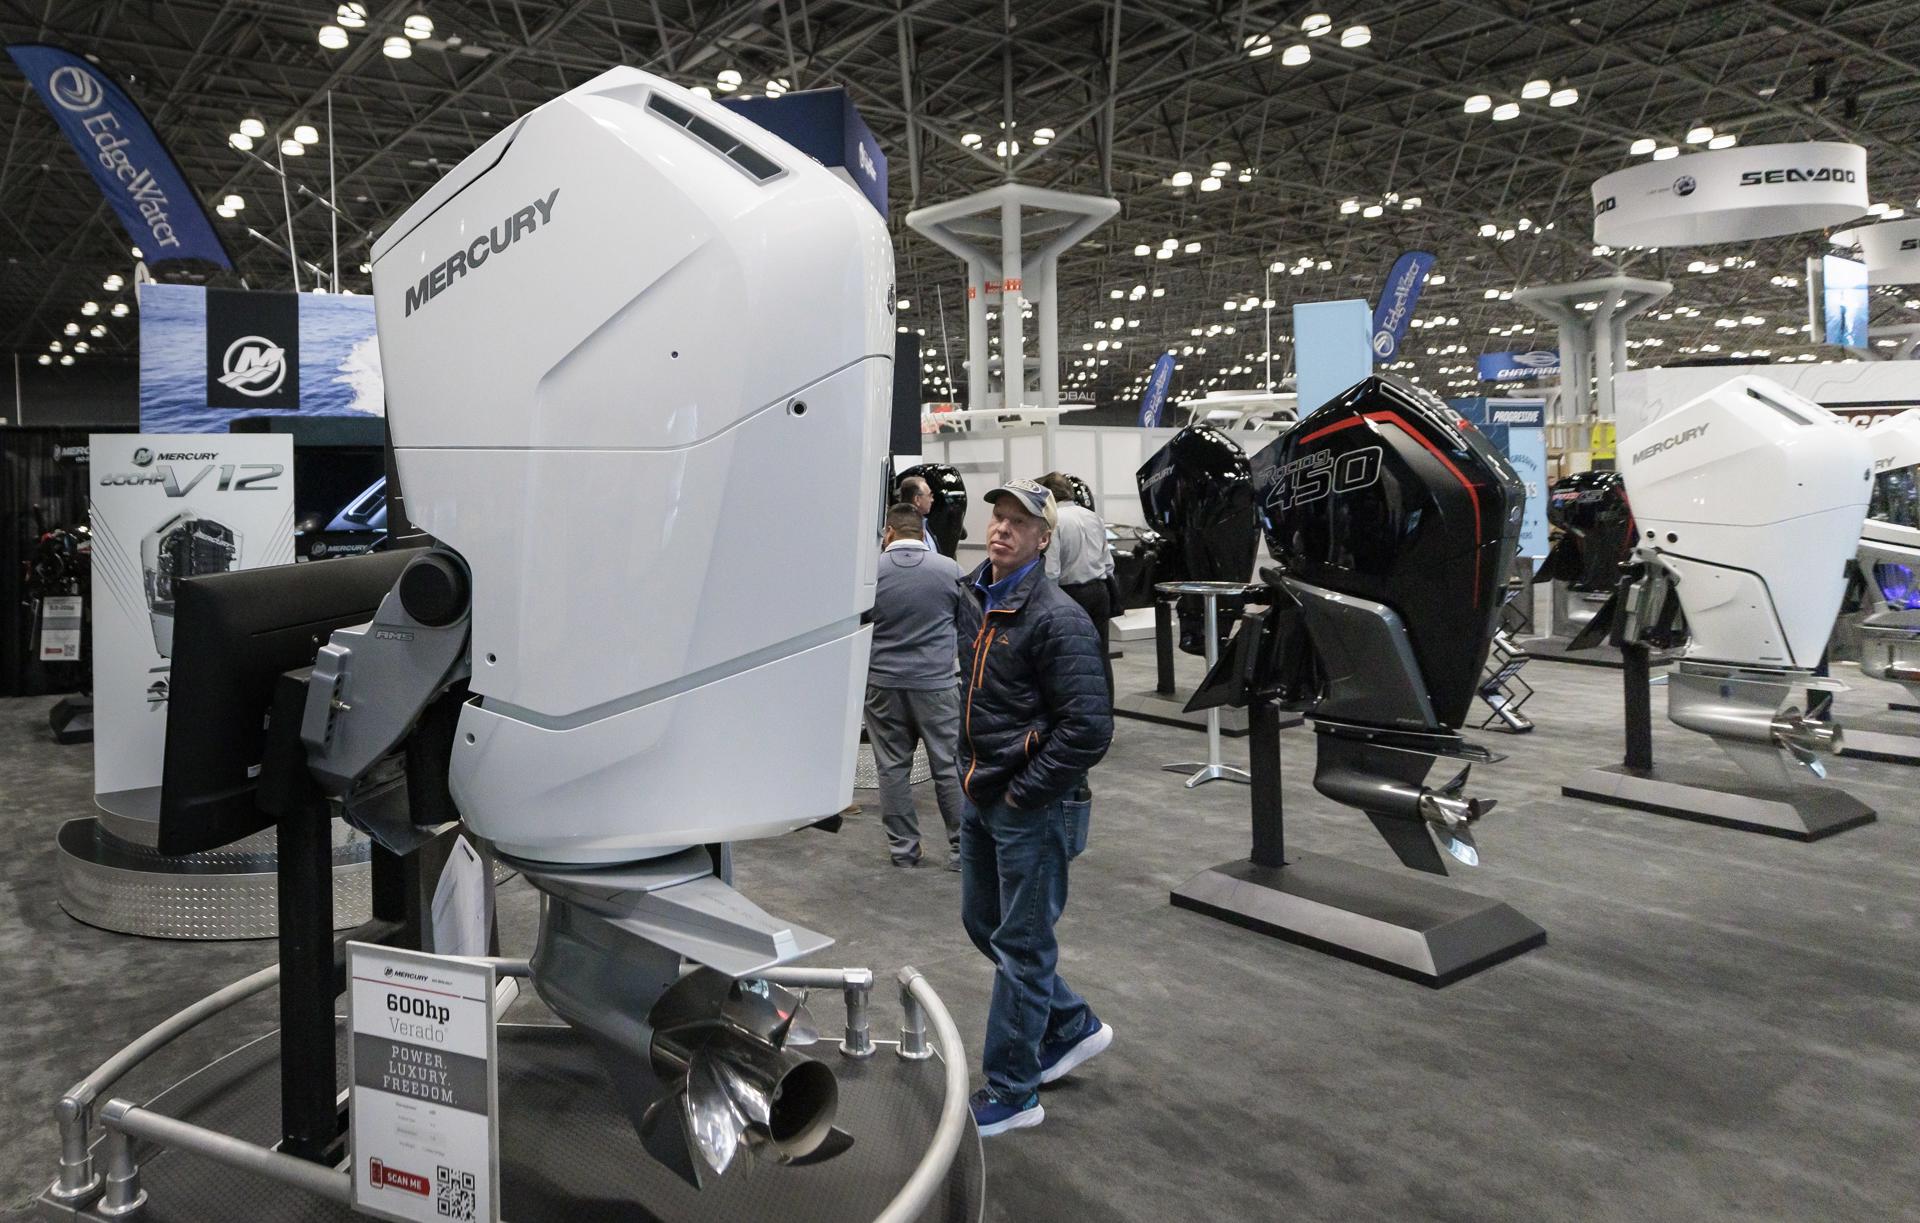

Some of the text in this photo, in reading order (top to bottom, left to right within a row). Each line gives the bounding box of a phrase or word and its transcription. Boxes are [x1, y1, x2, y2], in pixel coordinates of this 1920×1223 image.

[82, 111, 180, 248] EdgeWater
[405, 187, 560, 318] MERCURY
[1382, 258, 1420, 332] EdgeWater
[156, 452, 219, 461] MERCURY
[1632, 422, 1710, 465] MERCURY
[156, 463, 285, 497] V12
[1266, 446, 1383, 512] 450
[327, 544, 368, 552] MERCURY
[393, 970, 429, 982] MERCURY
[387, 993, 450, 1025] 600hp
[391, 1045, 448, 1070] POWER.
[389, 1061, 452, 1087] LUXURY.
[383, 1075, 458, 1105] FREEDOM.
[387, 1172, 422, 1191] SCAN ME
